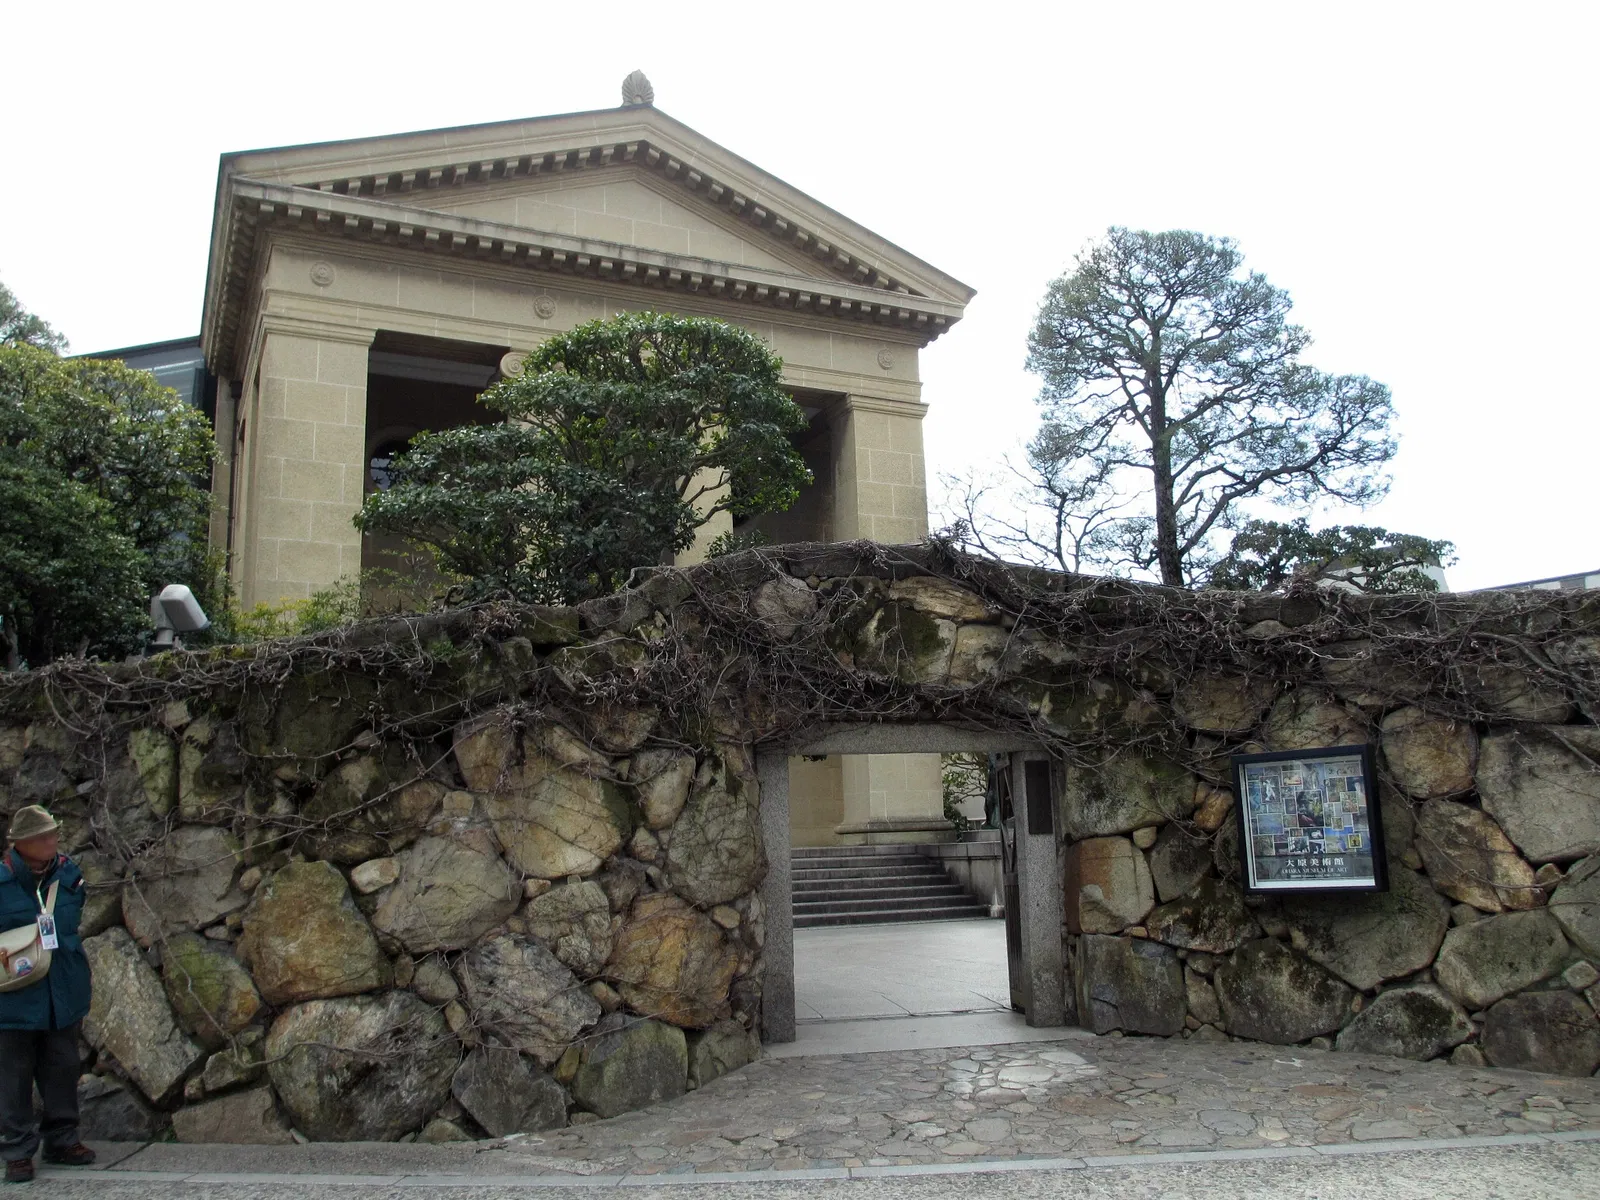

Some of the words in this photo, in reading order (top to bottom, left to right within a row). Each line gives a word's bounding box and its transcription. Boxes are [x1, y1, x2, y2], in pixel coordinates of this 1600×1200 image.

[1285, 857, 1344, 867] 大原美術館
